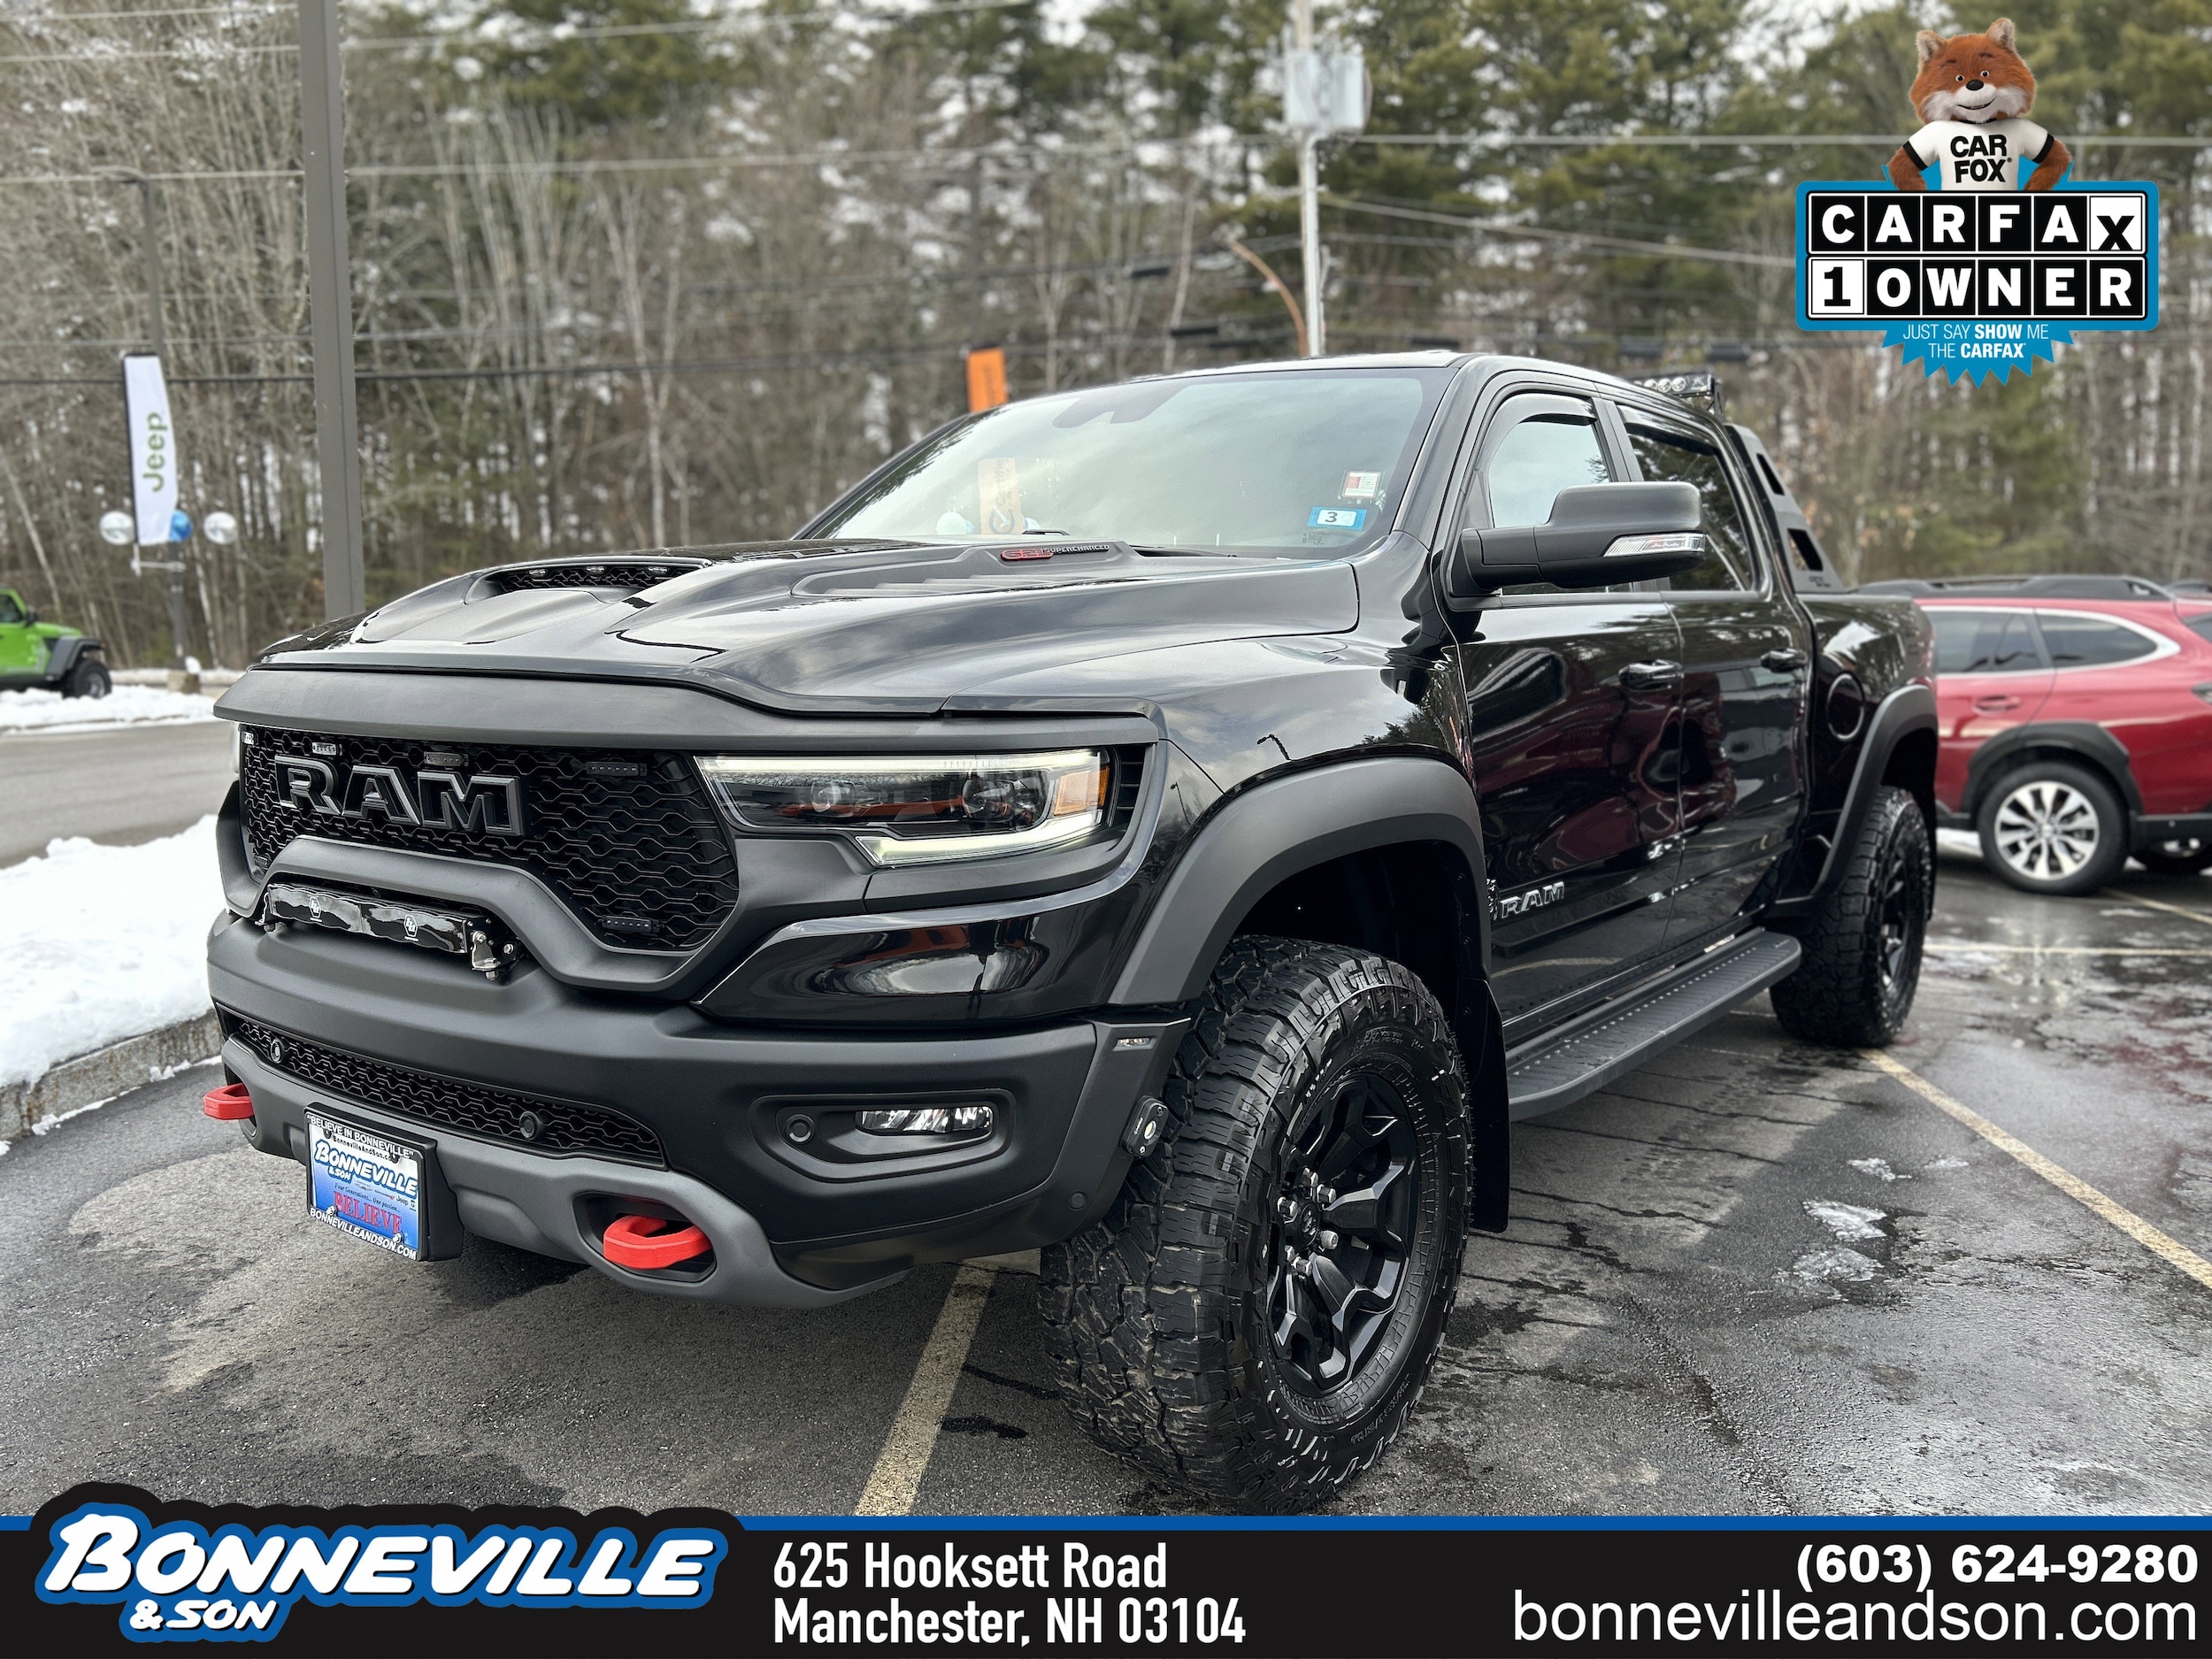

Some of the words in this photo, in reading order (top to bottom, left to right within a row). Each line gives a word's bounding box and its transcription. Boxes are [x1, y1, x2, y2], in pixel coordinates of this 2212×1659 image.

[141, 411, 168, 494] Jeep
[1325, 511, 1338, 523] 3
[274, 754, 525, 837] RAM
[1500, 880, 1564, 919] RAM
[333, 1135, 392, 1161] BonnevilleAndSon.co
[343, 1127, 353, 1139] IN
[315, 1140, 419, 1197] BONNEVILLE
[310, 1207, 417, 1261] BONNEVILLEANDSON.COM
[334, 1190, 403, 1234] BELIEVE
